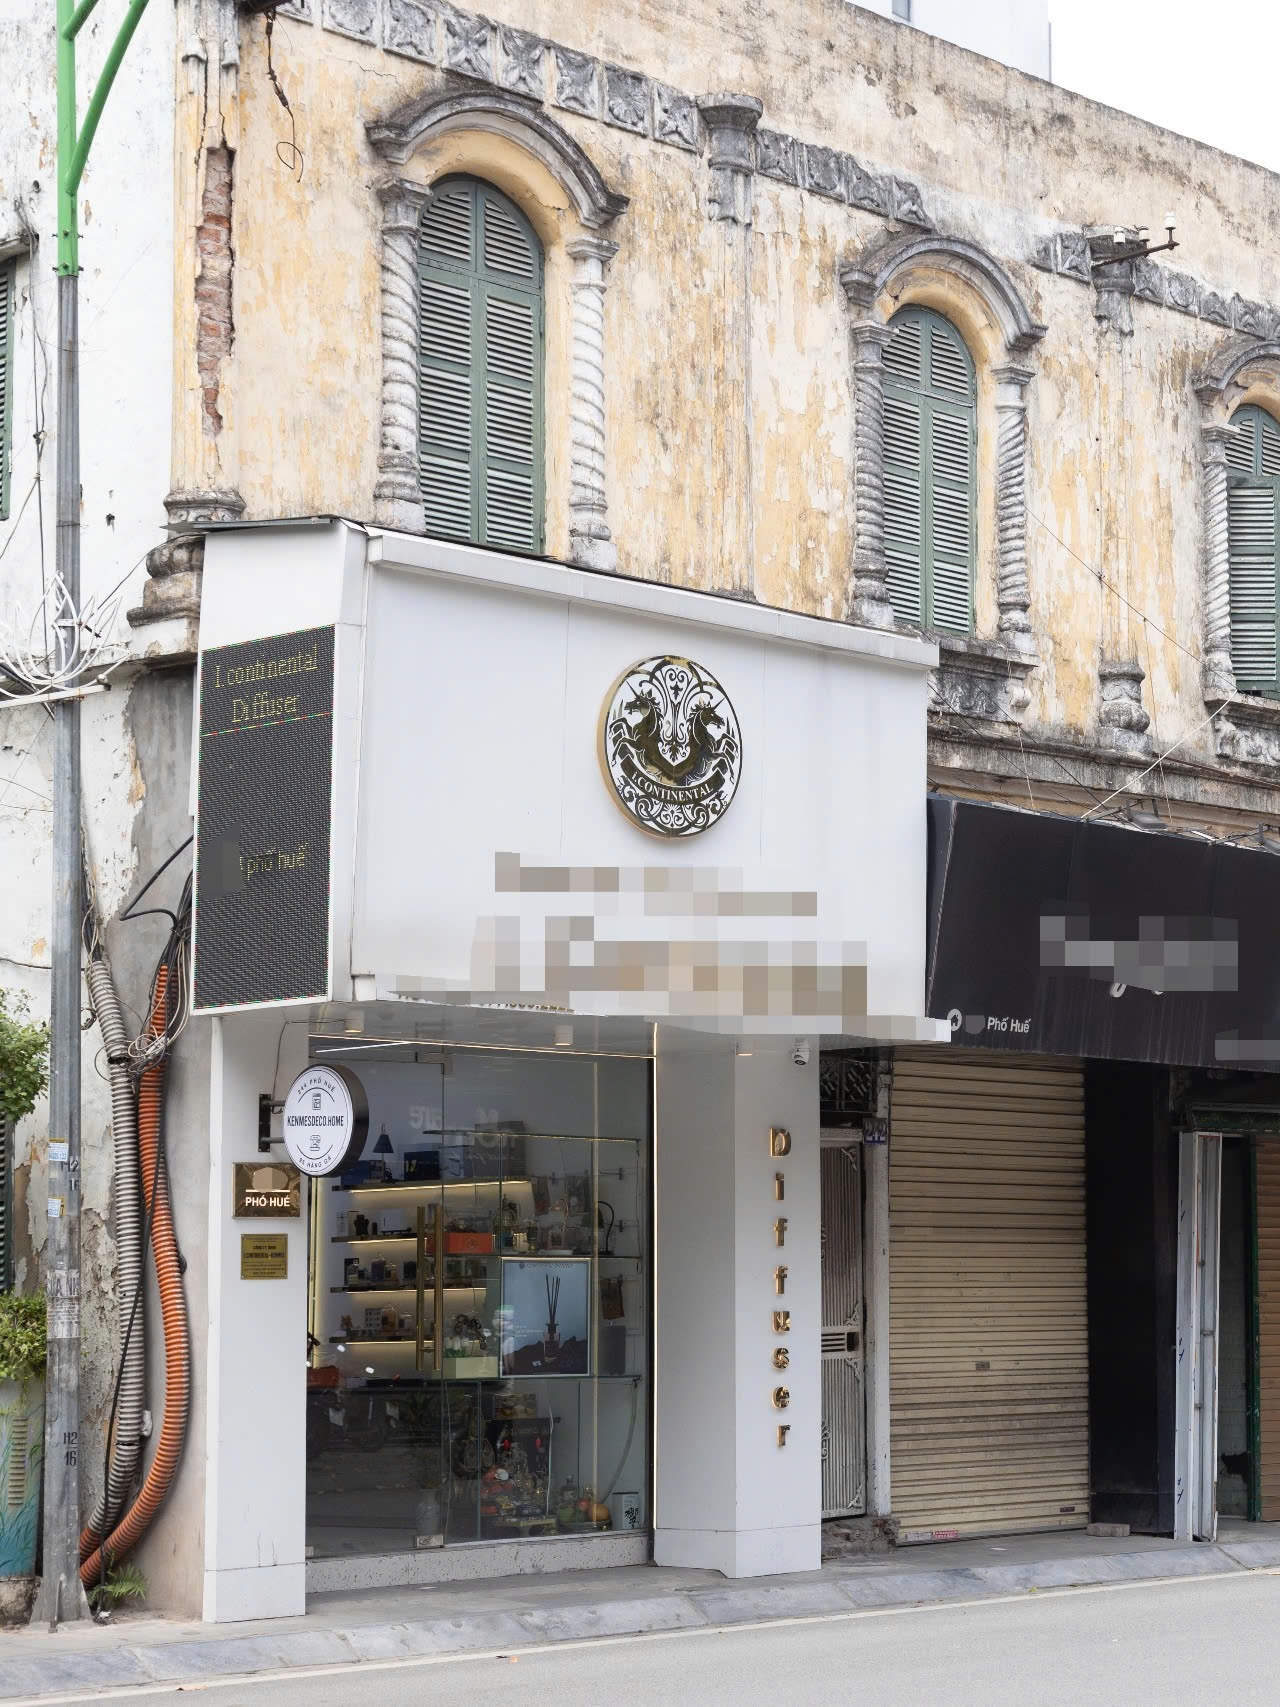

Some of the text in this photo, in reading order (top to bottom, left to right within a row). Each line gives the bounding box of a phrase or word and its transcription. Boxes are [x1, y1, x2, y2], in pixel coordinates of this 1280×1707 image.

[231, 692, 300, 723] Diffuser
[987, 1016, 1032, 1033] Phố Huế
[768, 1127, 793, 1449] Diffuser
[63, 1432, 78, 1445] H2
[64, 1450, 77, 1467] 16
